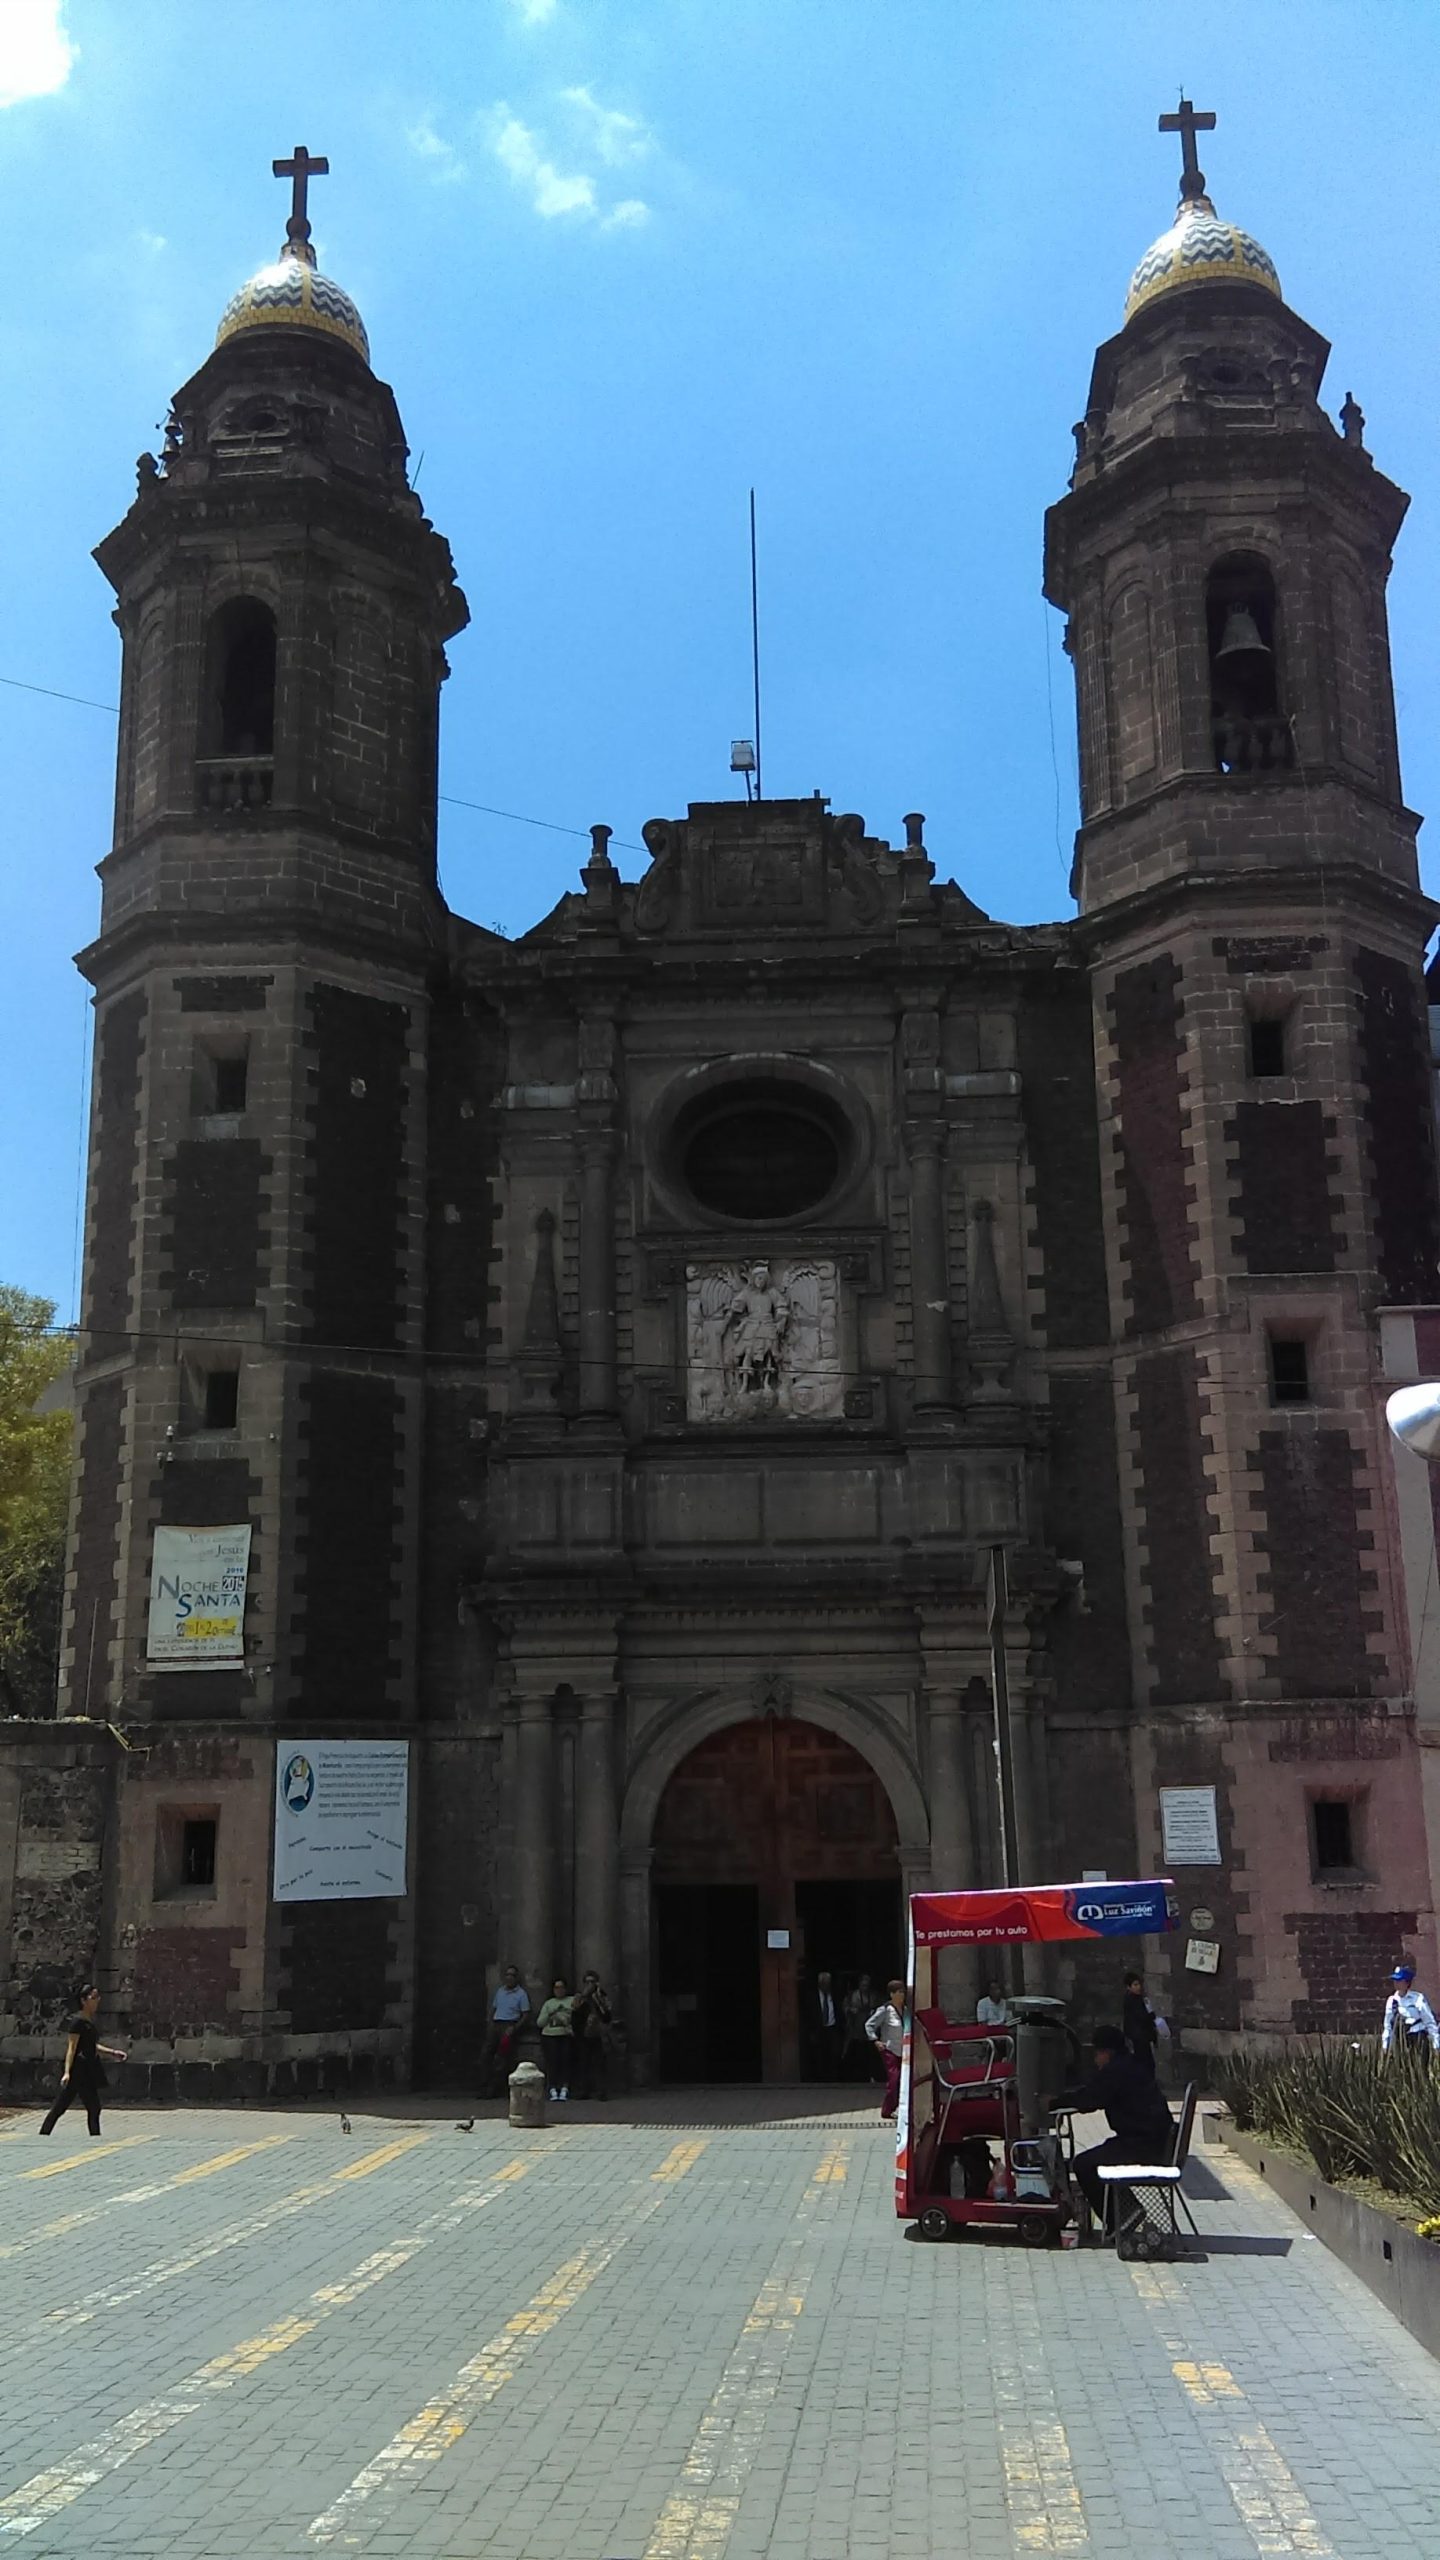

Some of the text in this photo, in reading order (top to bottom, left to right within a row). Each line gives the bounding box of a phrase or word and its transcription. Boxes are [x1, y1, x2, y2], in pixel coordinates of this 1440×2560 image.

[223, 1577, 244, 1591] 2015
[175, 1594, 241, 1617] SANTA
[915, 1926, 1028, 1940] Te prestamos por tu auto
